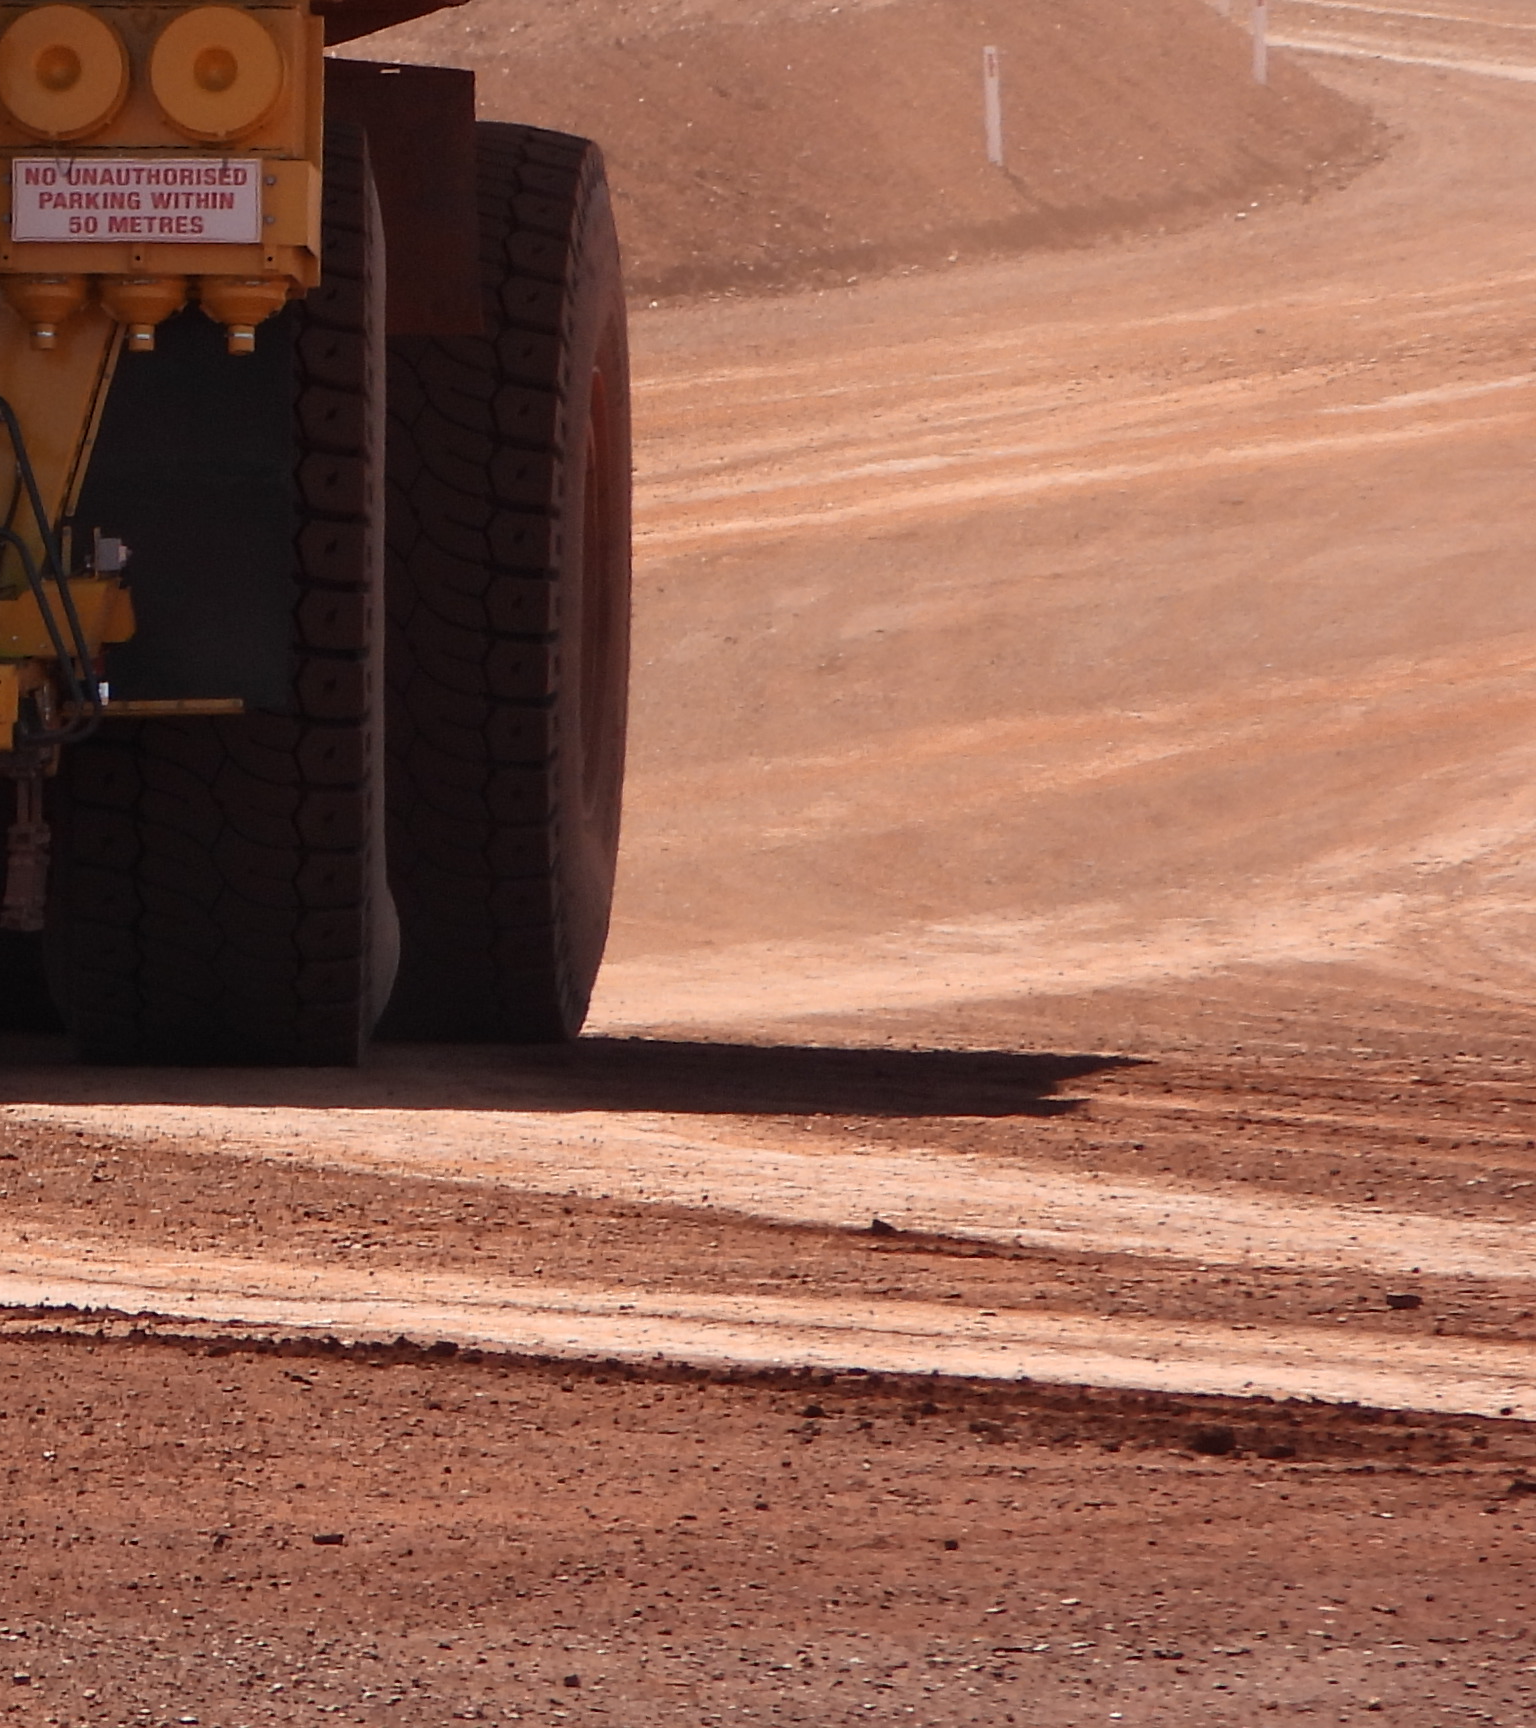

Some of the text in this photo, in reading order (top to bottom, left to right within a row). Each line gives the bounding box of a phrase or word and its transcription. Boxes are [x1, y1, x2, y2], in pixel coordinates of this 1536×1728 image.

[25, 168, 247, 186] NO UNAUTHORISED
[38, 192, 235, 210] PARKING WITHIN
[69, 216, 204, 235] 50 METRES
